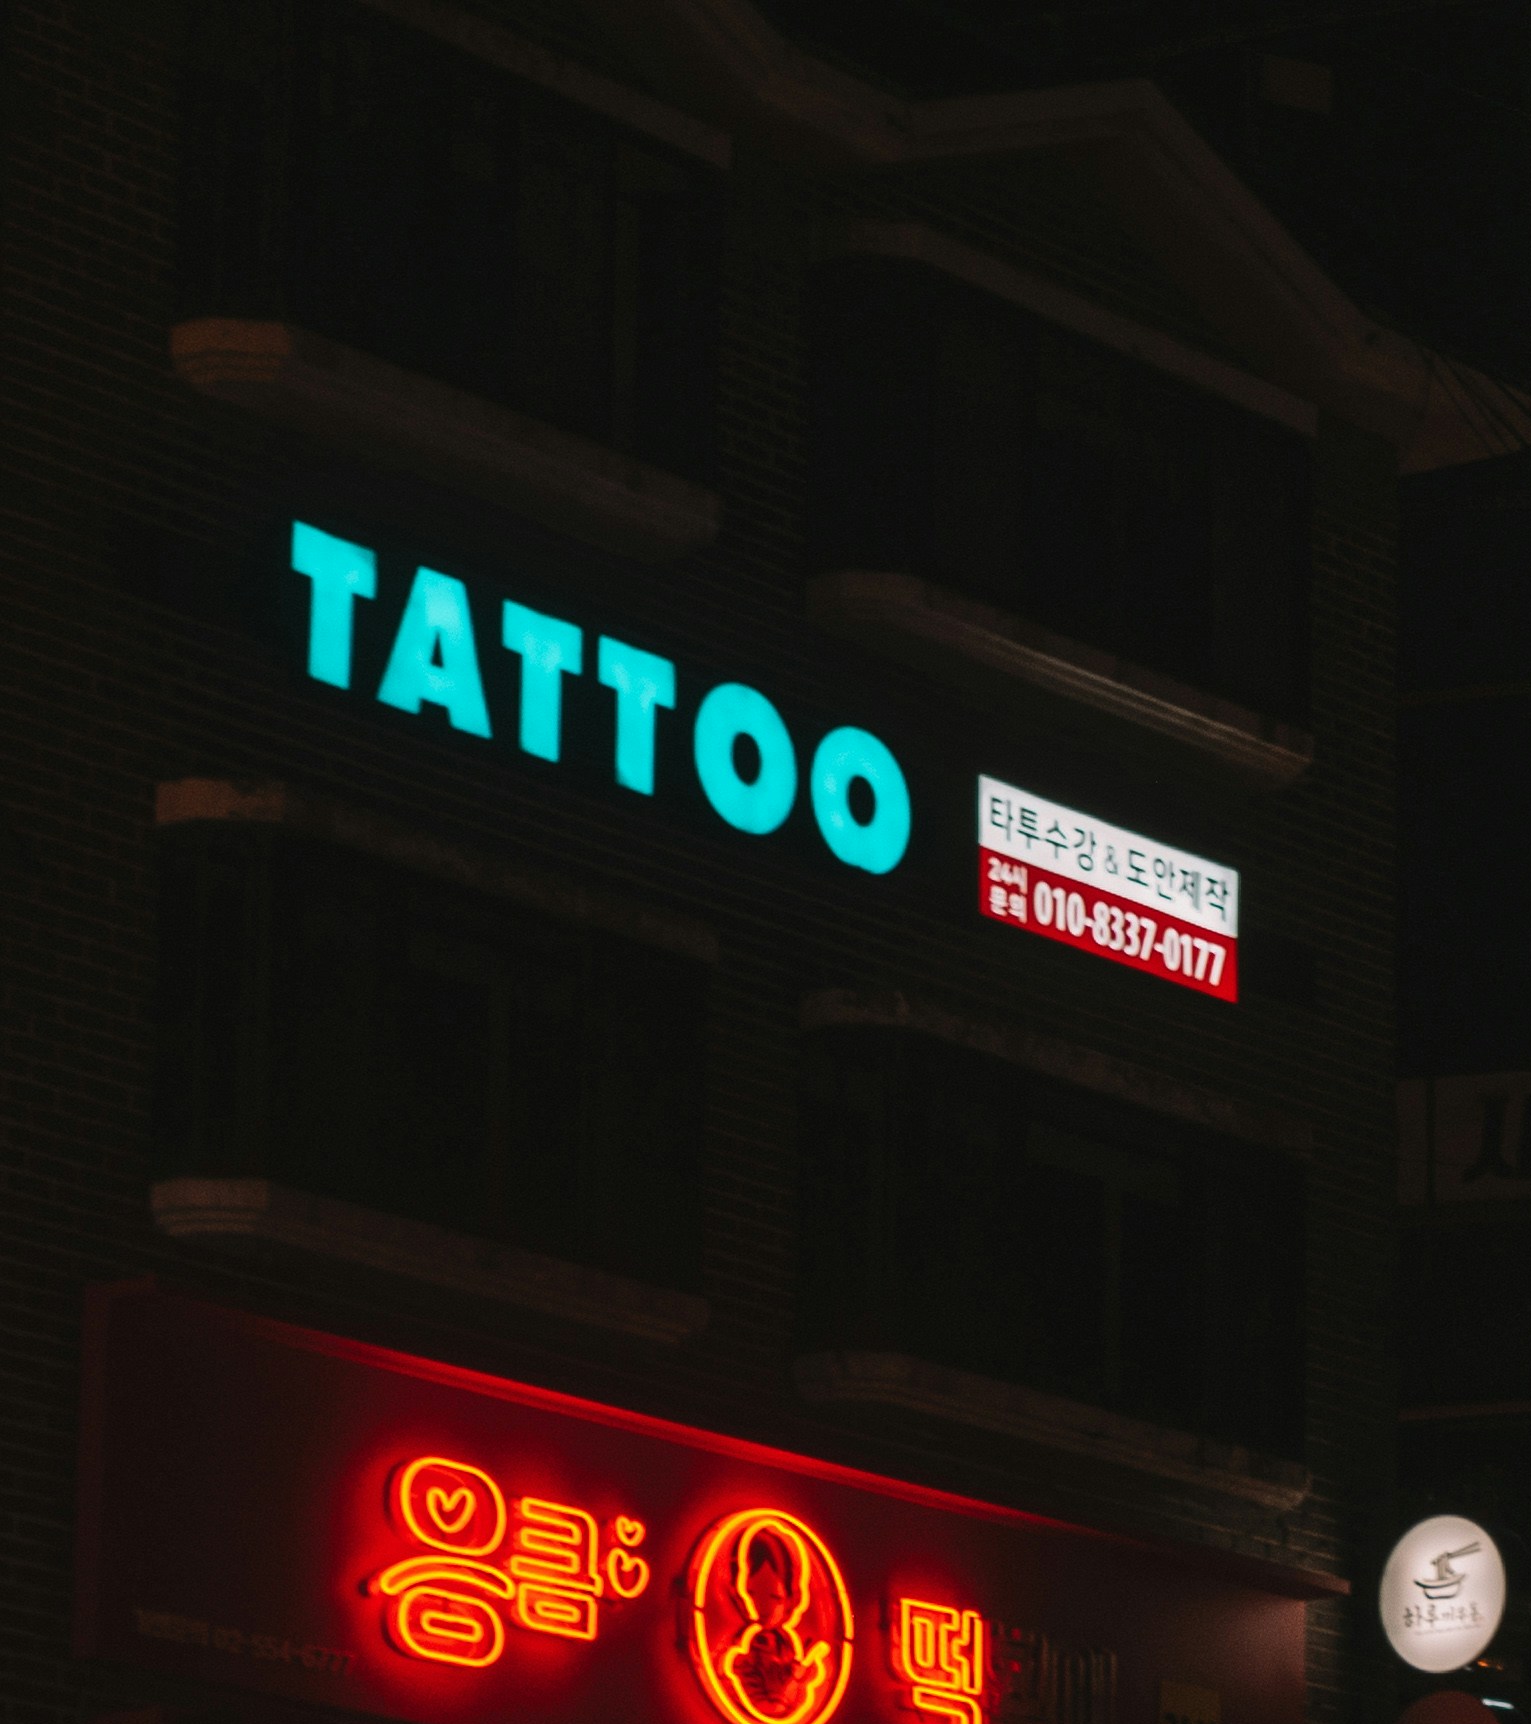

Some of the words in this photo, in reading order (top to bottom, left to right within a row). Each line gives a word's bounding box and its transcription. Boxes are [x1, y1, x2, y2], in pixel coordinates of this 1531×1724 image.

[292, 521, 912, 874] TATTOO
[991, 797, 1097, 872] 타투수강
[1127, 849, 1229, 922] 도안제작
[1034, 881, 1226, 987] 010-8337-0177
